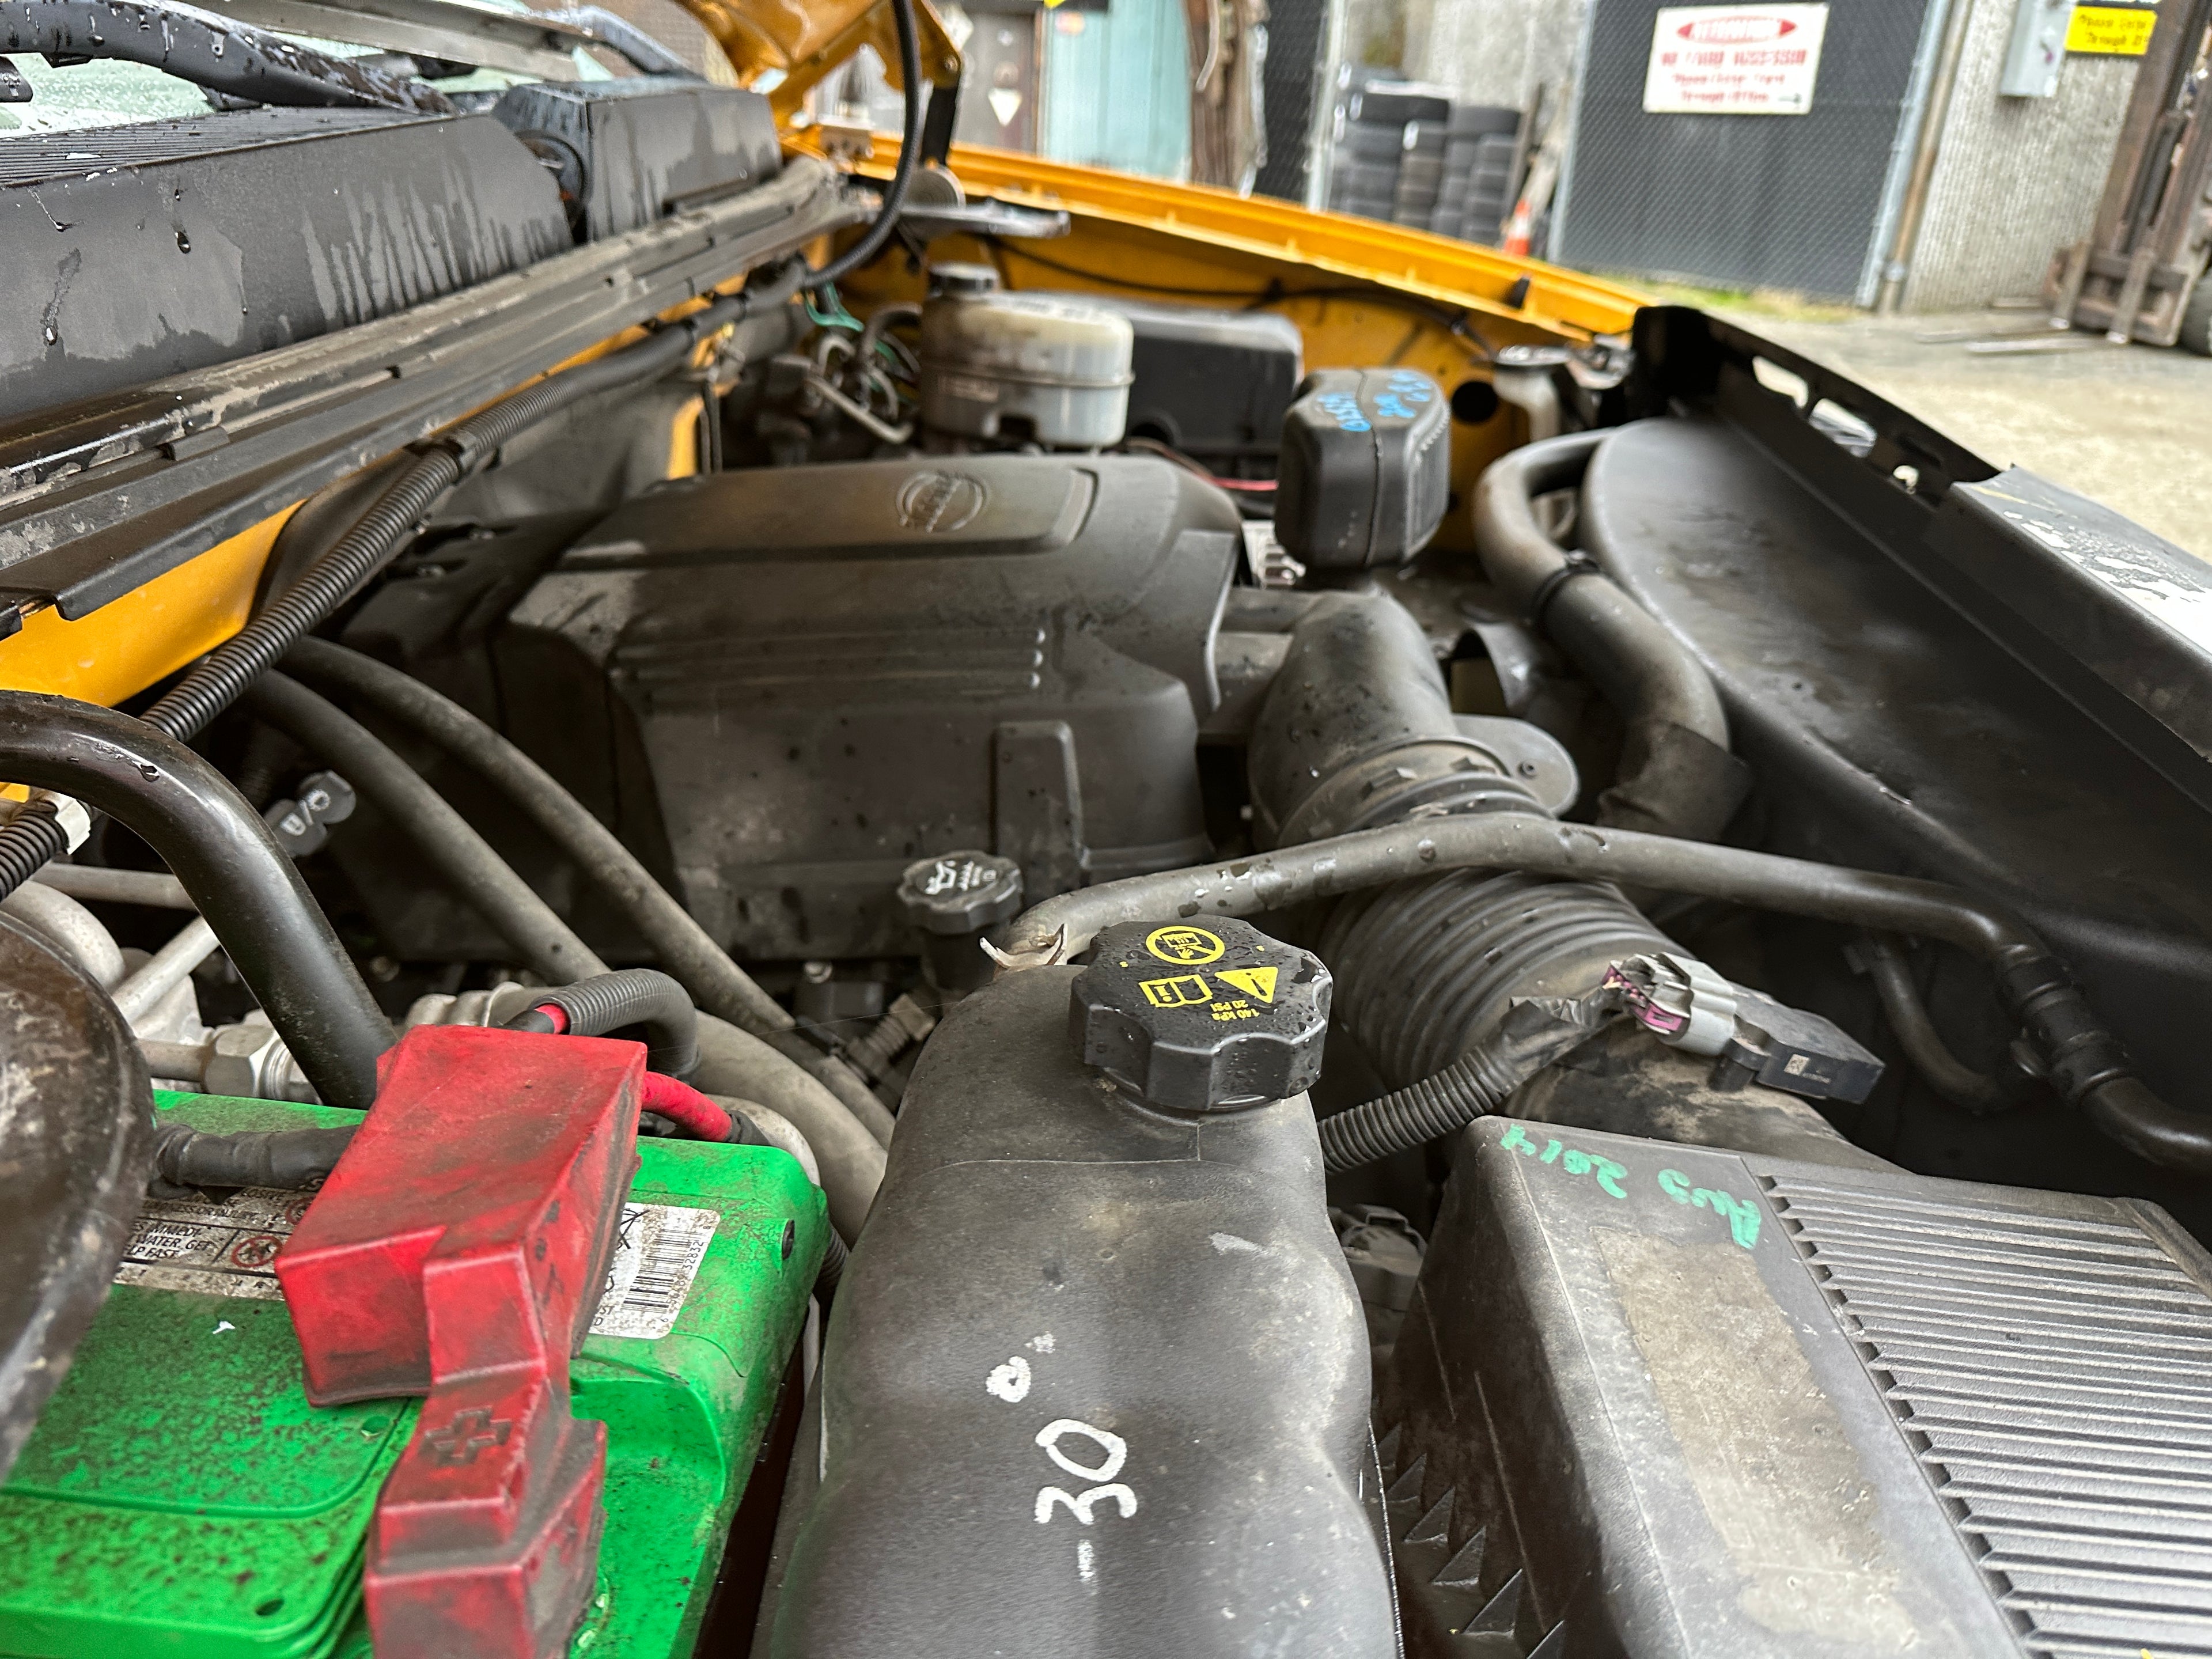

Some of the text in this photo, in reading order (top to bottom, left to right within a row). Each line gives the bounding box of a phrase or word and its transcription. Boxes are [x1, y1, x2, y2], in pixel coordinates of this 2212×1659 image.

[1210, 999, 1249, 1012] 20 PSI
[1211, 1008, 1260, 1021] 140 kPa
[682, 1240, 704, 1270] 32832
